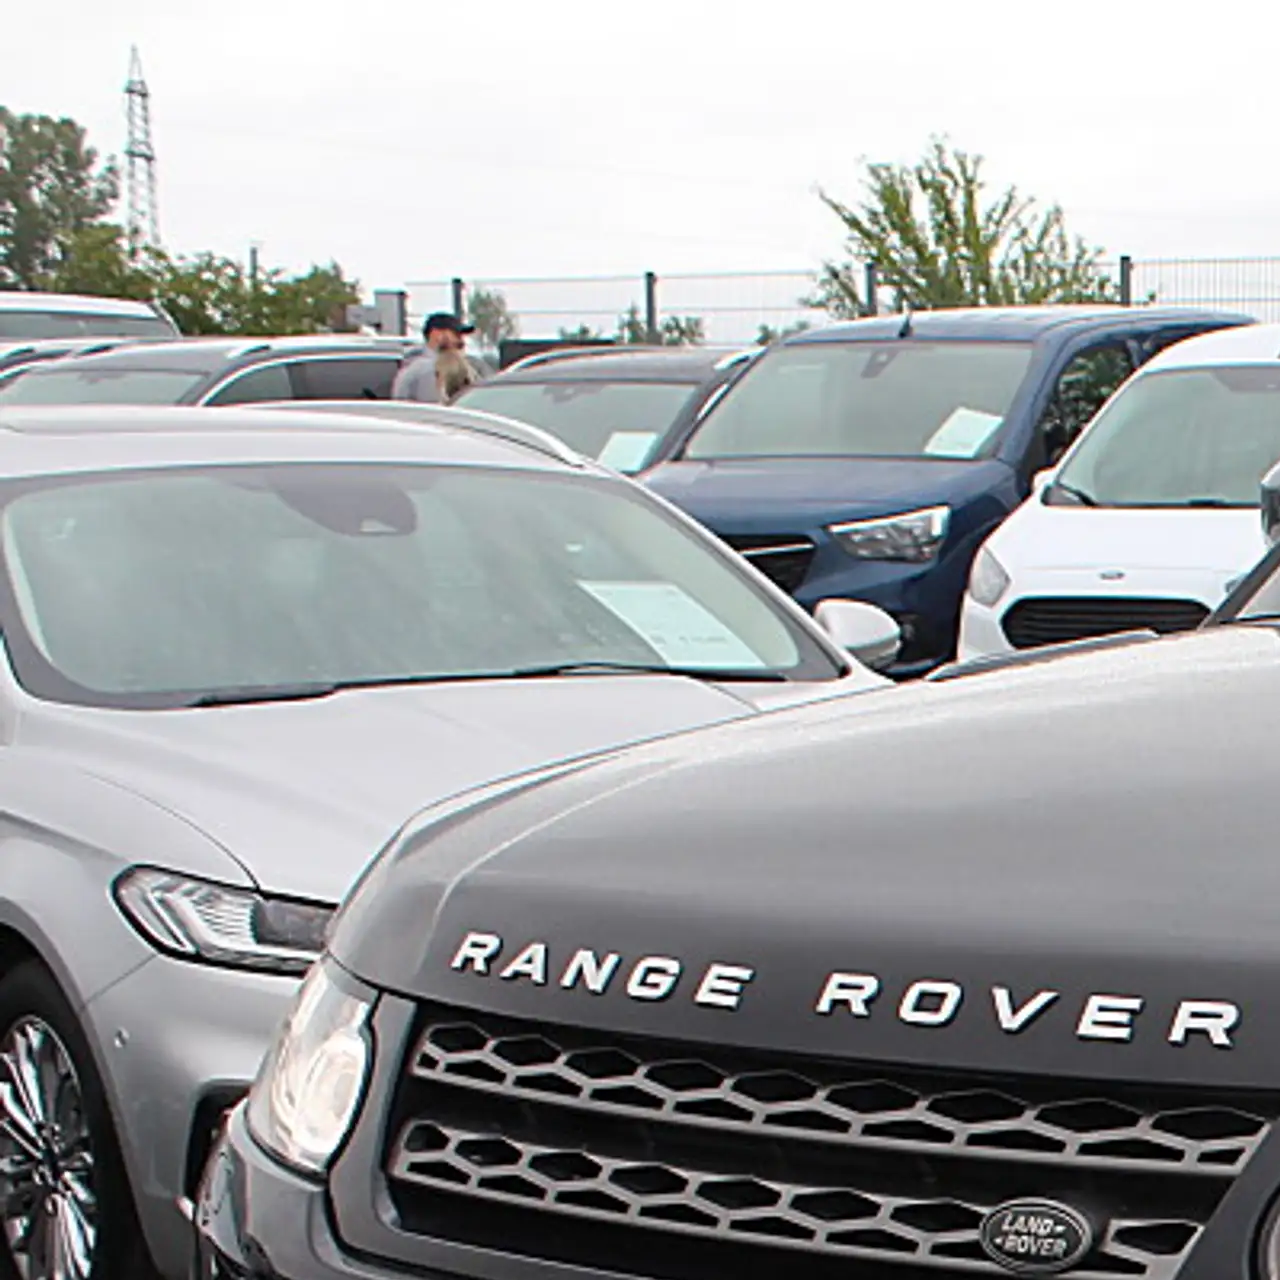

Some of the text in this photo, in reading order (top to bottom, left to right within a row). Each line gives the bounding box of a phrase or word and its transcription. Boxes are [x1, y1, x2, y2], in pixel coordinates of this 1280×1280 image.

[450, 930, 1243, 1047] RANGE ROVER
[1001, 1210, 1056, 1236] LAND
[1002, 1234, 1067, 1259] ROVER
